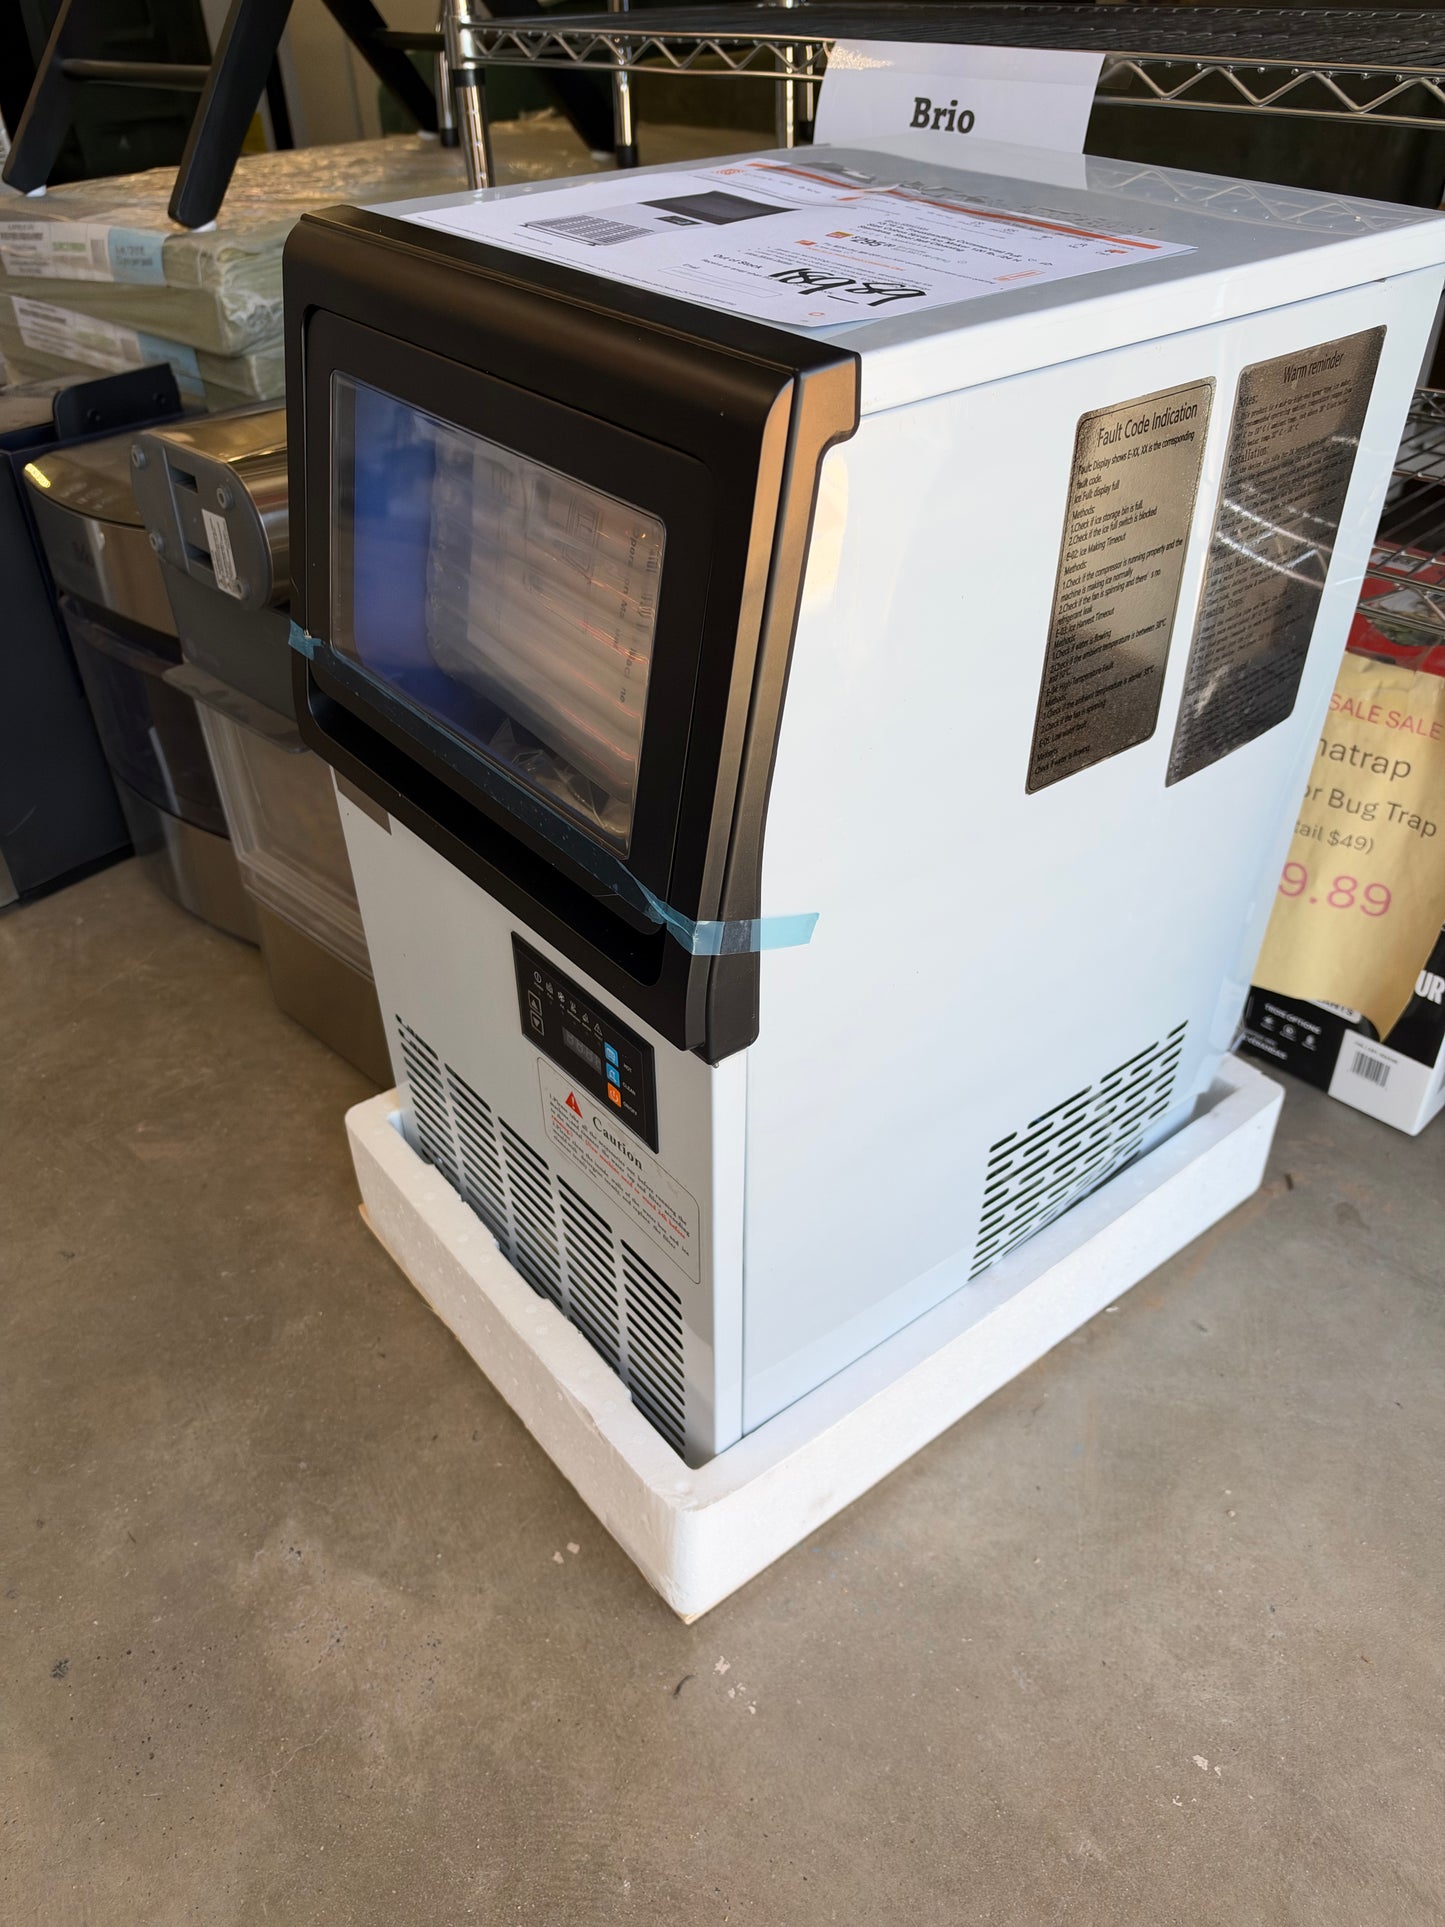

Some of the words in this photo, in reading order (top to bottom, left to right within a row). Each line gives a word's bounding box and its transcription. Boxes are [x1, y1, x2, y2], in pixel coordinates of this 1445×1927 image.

[909, 96, 976, 135] Brio
[1283, 363, 1307, 384] Warm
[1308, 351, 1345, 377] reminder
[1097, 422, 1123, 447] Fault
[1123, 415, 1149, 440] Code
[1151, 402, 1197, 432] Indication
[1093, 457, 1110, 469] Display
[1111, 453, 1126, 463] shows
[1148, 443, 1152, 451] is
[1153, 440, 1161, 449] the
[1162, 431, 1194, 446] corresponding
[1093, 484, 1110, 497] display
[1072, 505, 1095, 519] Methods:
[1102, 511, 1119, 521] storage
[1121, 506, 1129, 514] bin
[1139, 506, 1157, 520] blocked
[1088, 541, 1105, 552] Making
[1106, 532, 1126, 546] Timeout
[1095, 560, 1122, 575] compressor
[1128, 553, 1145, 564] running
[1145, 544, 1165, 559] properly
[1166, 539, 1174, 549] and
[1060, 589, 1080, 601] machine
[1087, 580, 1104, 591] making
[1113, 567, 1133, 580] normally
[1064, 561, 1086, 575] Methods:
[1329, 693, 1383, 725] SALE
[1385, 710, 1444, 741] SALE
[1328, 788, 1379, 821] Bug
[1387, 801, 1437, 838] Trap
[1327, 829, 1374, 855] $49)
[1278, 862, 1392, 917] 9.89
[1414, 969, 1445, 1005] UR
[592, 1113, 642, 1170] Caution
